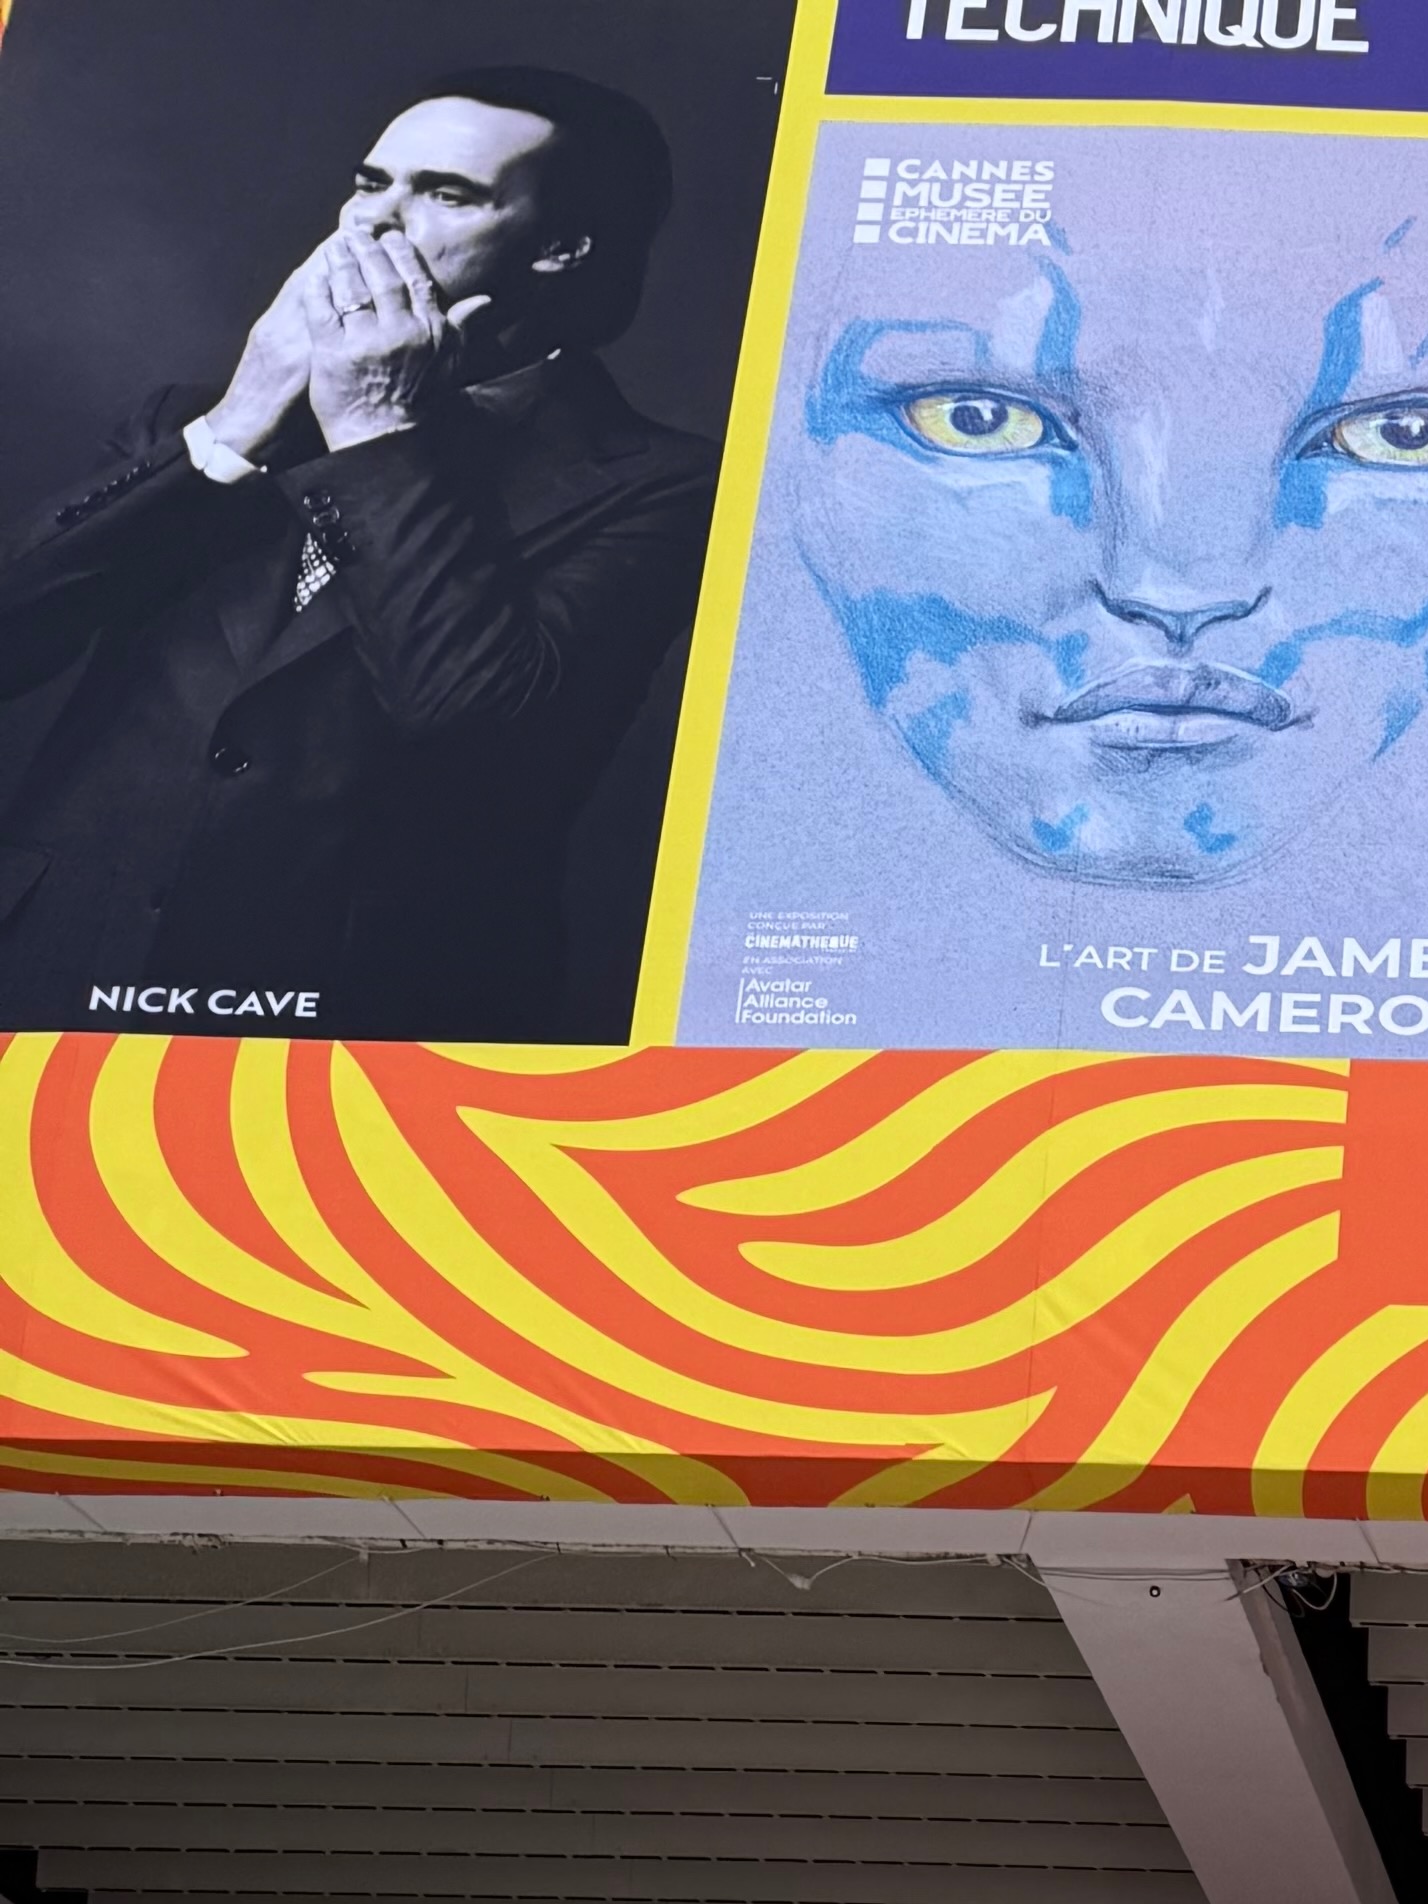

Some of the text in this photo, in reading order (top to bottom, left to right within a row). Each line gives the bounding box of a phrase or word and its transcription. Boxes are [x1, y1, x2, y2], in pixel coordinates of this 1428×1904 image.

[896, 158, 1055, 181] CANNES
[893, 181, 1053, 208] MUSEE
[890, 207, 1052, 223] EPHEMERE DU
[888, 221, 1051, 245] CINEMA
[1039, 943, 1158, 971] L'ART
[1169, 949, 1226, 974] DE
[745, 978, 813, 993] Avatar
[89, 985, 320, 1018] NICK CAVE
[742, 993, 828, 1008] Alliance
[741, 1009, 857, 1025] Foundation
